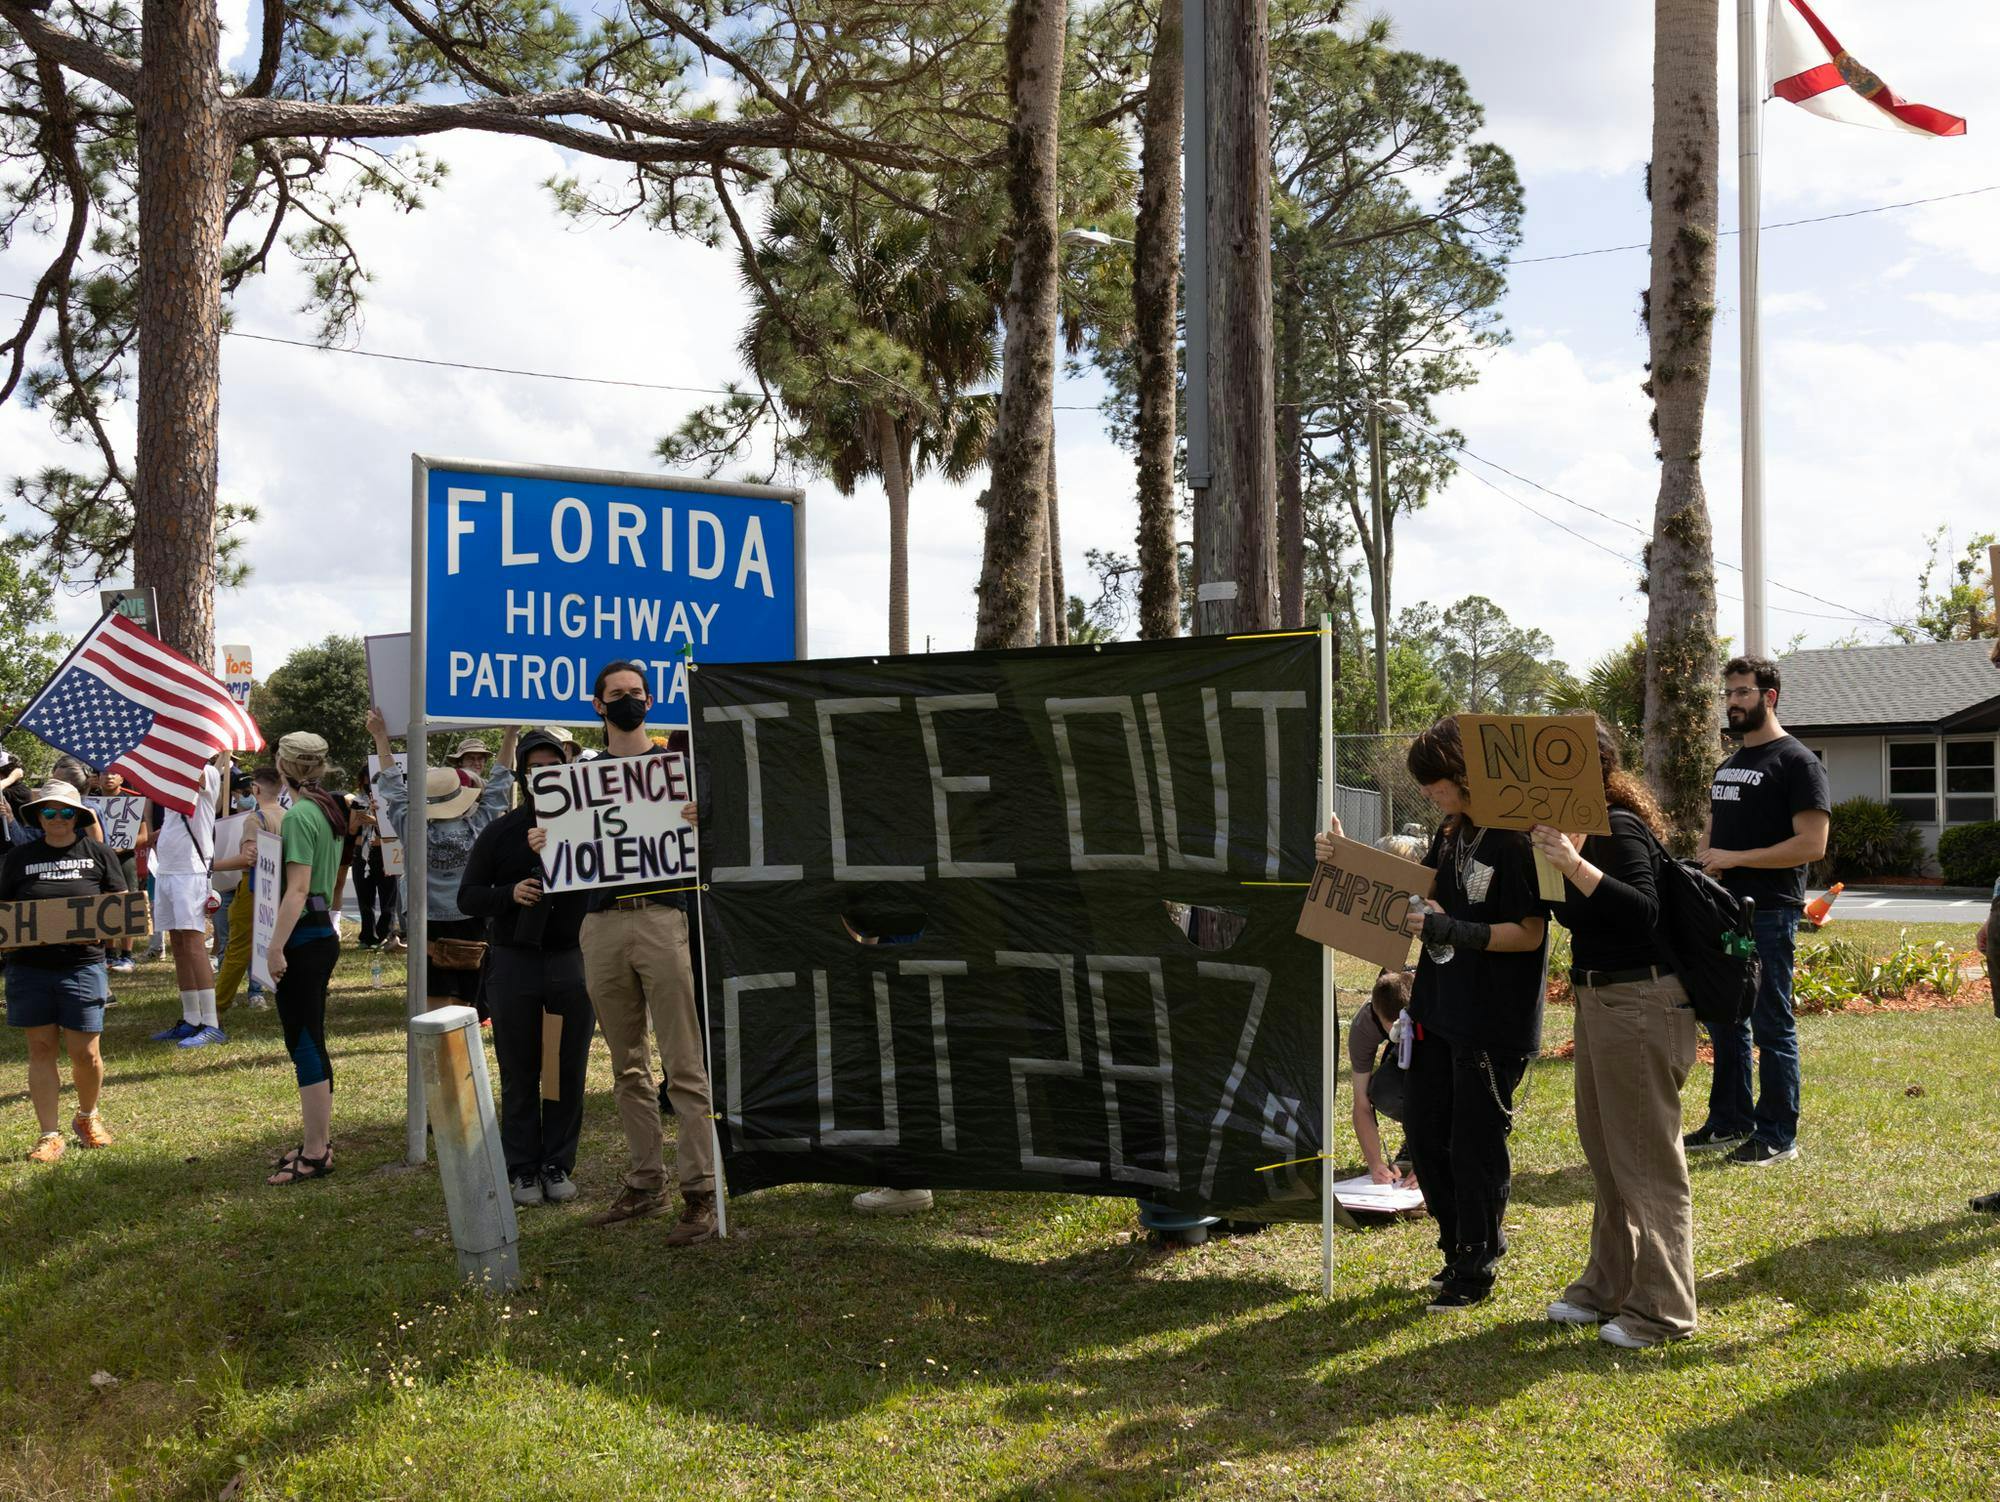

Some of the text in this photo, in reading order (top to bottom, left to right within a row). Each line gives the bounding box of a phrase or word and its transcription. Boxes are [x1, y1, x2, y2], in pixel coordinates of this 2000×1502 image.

[447, 487, 775, 598] FLORIDA
[506, 589, 720, 645] HIGHWAY
[449, 651, 689, 705] PATROL TA
[1479, 723, 1588, 783] NO
[703, 687, 1307, 882] ICE OUT
[65, 894, 146, 940] ICE
[723, 959, 969, 1152] CUT
